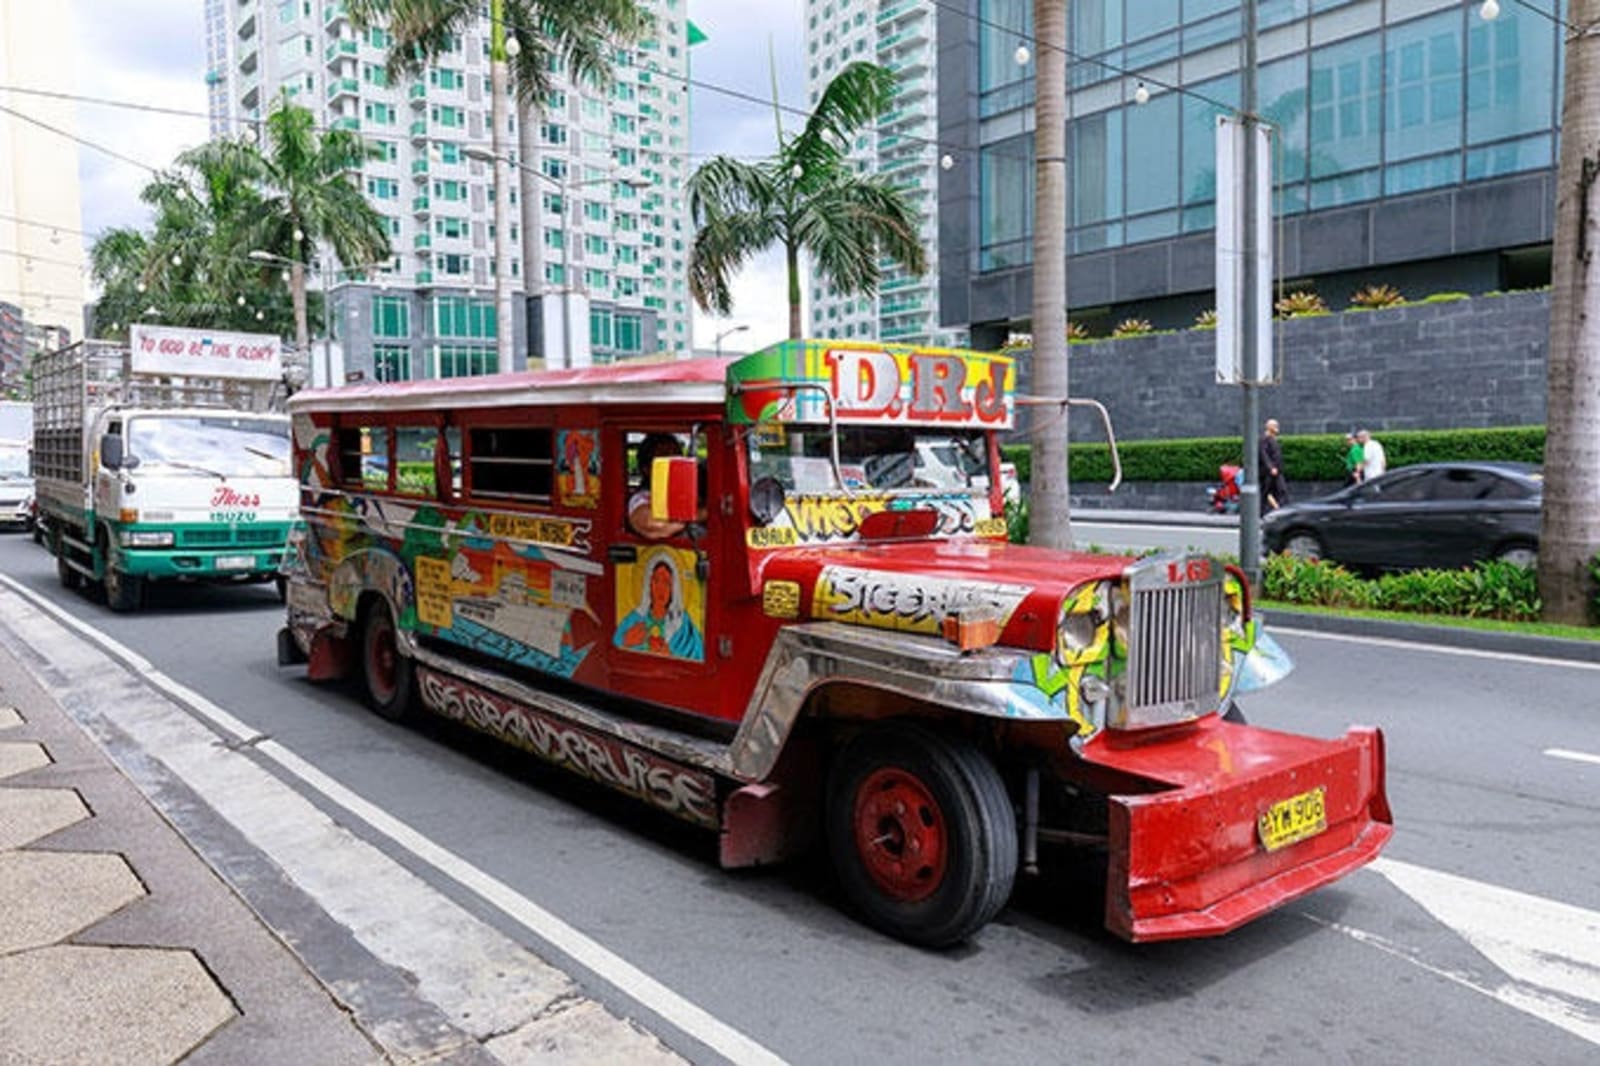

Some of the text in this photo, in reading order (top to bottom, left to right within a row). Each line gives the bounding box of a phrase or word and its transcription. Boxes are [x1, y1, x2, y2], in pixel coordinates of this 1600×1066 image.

[140, 336, 156, 353] TO
[159, 338, 185, 355] GOD
[235, 344, 275, 361] GLORY
[210, 511, 257, 521] ISUZU
